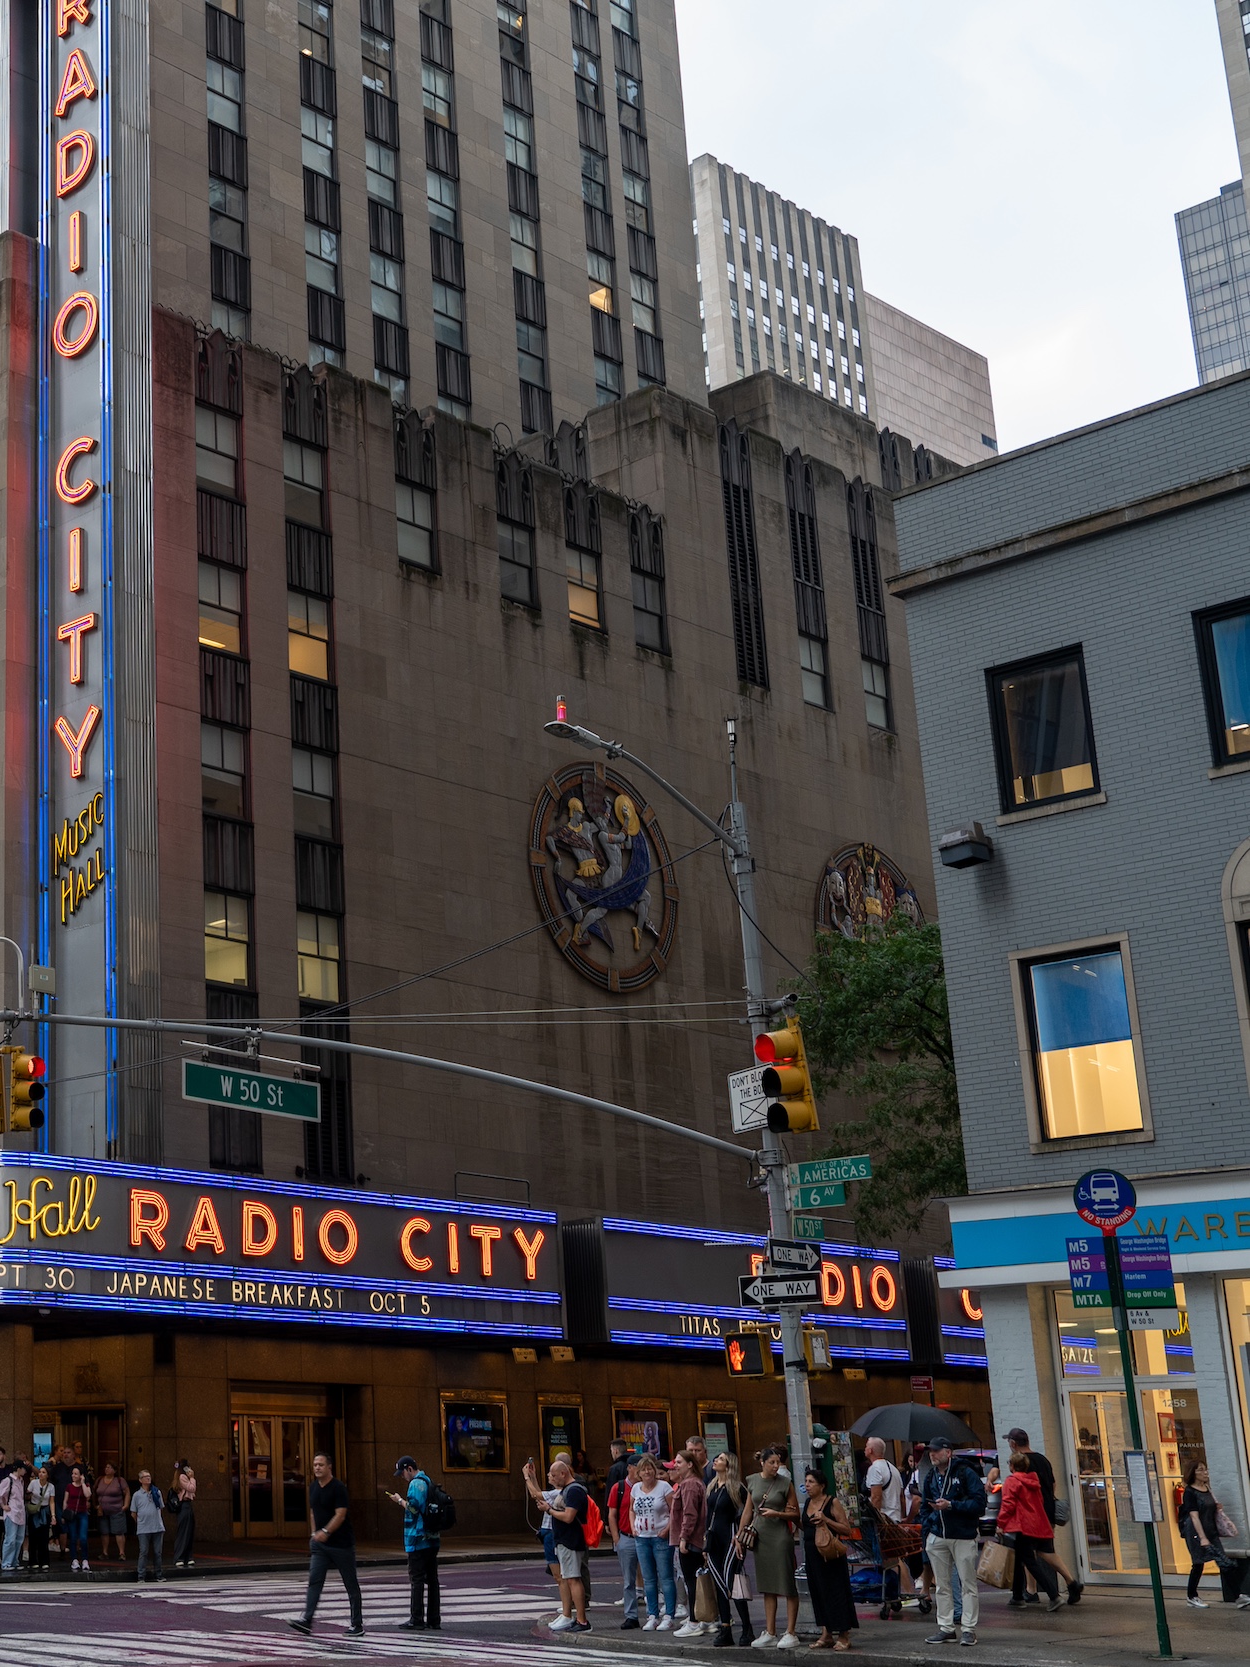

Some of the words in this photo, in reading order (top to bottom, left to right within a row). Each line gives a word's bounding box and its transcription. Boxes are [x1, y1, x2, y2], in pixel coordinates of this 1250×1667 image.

[54, 436, 102, 779] CITY
[731, 1075, 749, 1088] DON'T
[751, 1071, 764, 1083] BLO
[220, 1075, 233, 1097] W
[240, 1079, 260, 1102] 50
[267, 1084, 283, 1107] St
[740, 1088, 751, 1099] THE
[753, 1084, 764, 1096] BO
[803, 1164, 867, 1182] AMERICAS
[810, 1189, 821, 1205] 6
[824, 1186, 835, 1196] AV
[1082, 1209, 1095, 1221] NO
[1095, 1209, 1133, 1225] STANDING
[130, 1188, 359, 1266] RADIO
[400, 1216, 545, 1280] CITY
[797, 1219, 804, 1236] W
[804, 1220, 814, 1237] 50
[814, 1221, 821, 1230] ST
[1068, 1240, 1088, 1252] M5
[777, 1248, 792, 1261] ONE
[798, 1250, 814, 1263] WAY
[1070, 1257, 1091, 1270] M5
[45, 1266, 75, 1290] 30
[1073, 1274, 1092, 1288] M7
[107, 1272, 217, 1301] JAPANESE
[232, 1280, 345, 1309] BREAKFAST
[370, 1291, 407, 1315] OCT
[420, 1294, 431, 1315] 5
[752, 1284, 775, 1297] ONE
[785, 1282, 810, 1295] WAY
[1127, 1291, 1141, 1299] Drop
[1153, 1290, 1167, 1298] Only
[1075, 1294, 1103, 1305] MTA
[679, 1315, 720, 1336] TITAS
[1148, 1317, 1154, 1325] St
[1163, 1399, 1186, 1408] 1258
